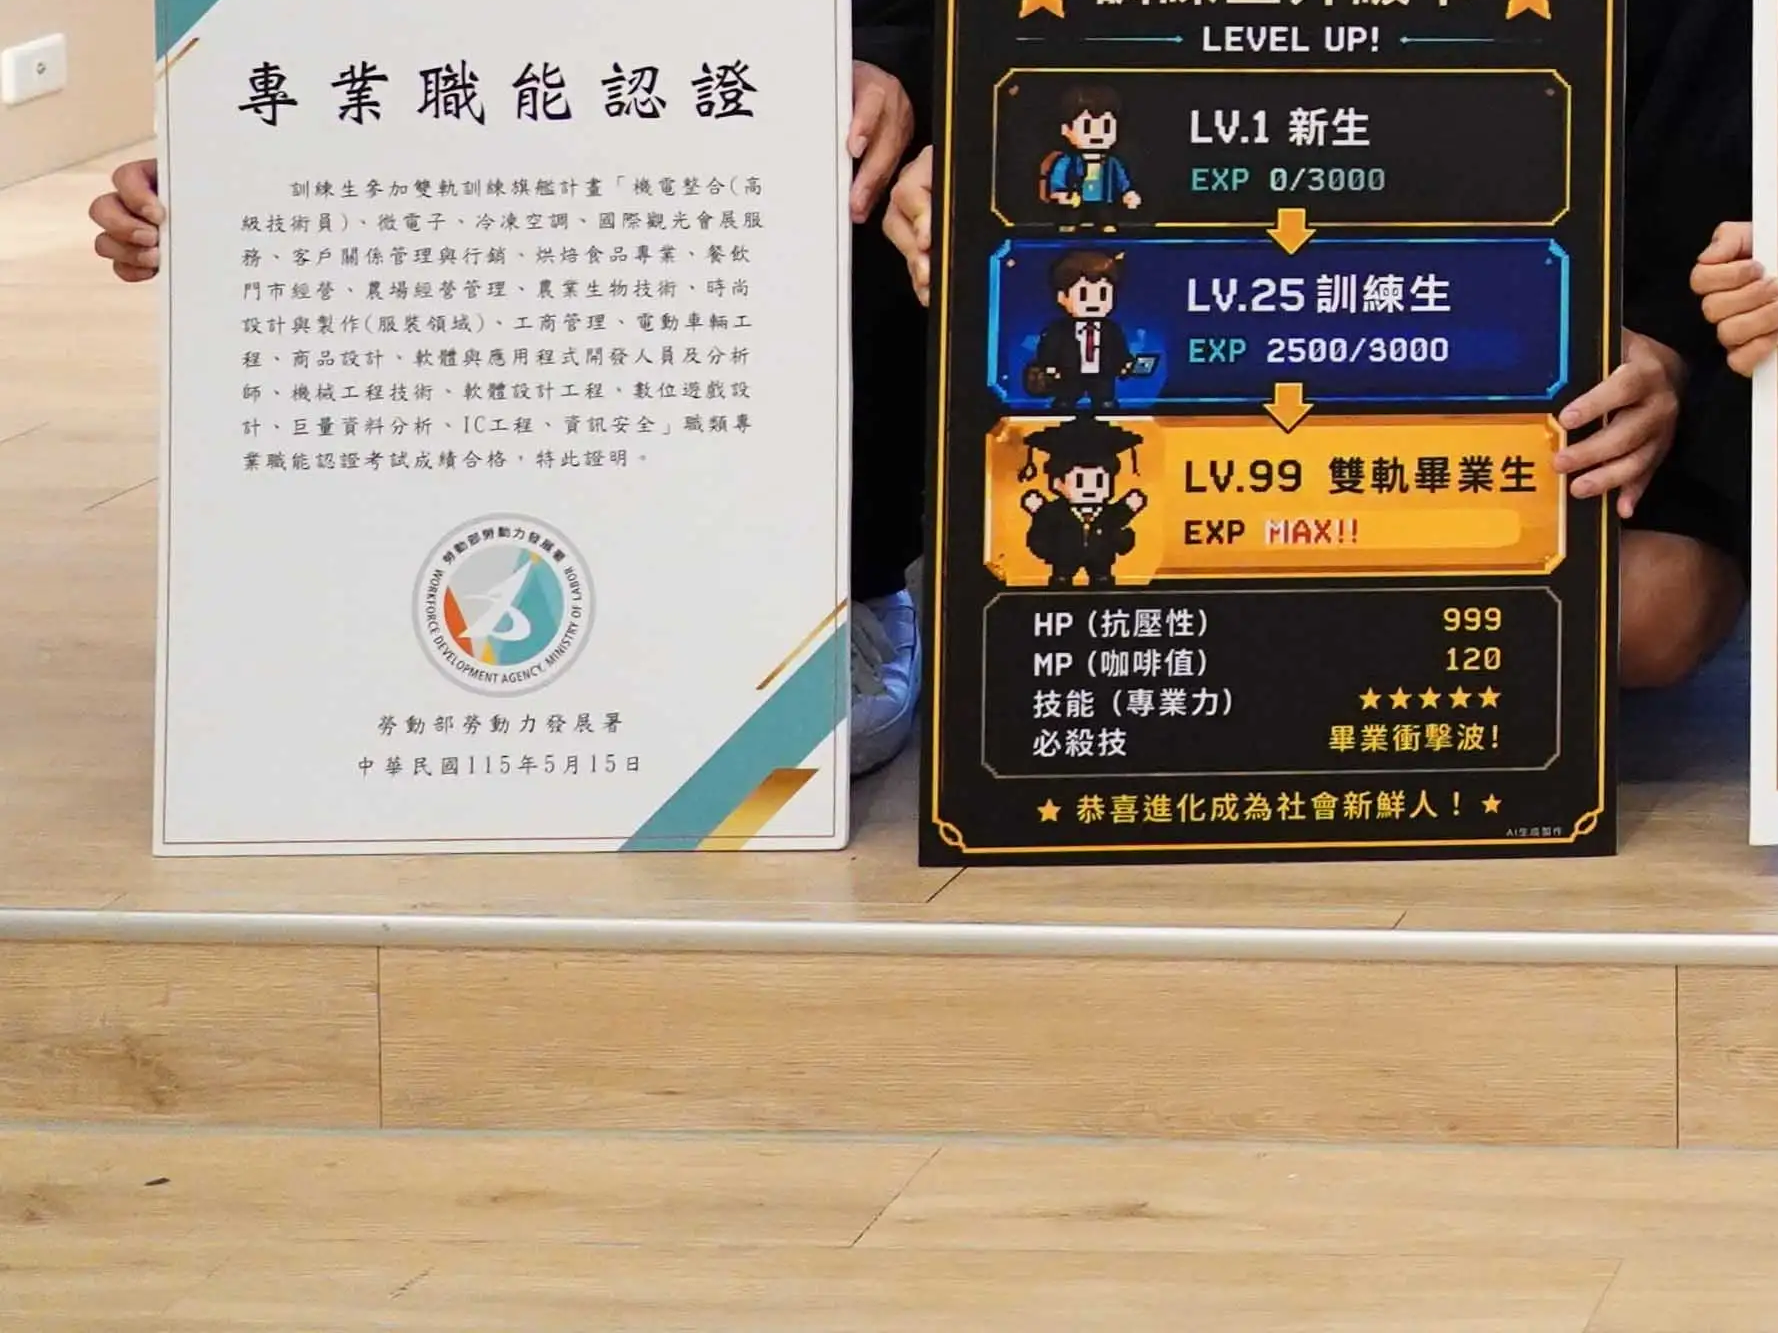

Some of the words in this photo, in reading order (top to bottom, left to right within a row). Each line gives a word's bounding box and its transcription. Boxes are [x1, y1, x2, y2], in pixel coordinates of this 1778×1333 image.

[1202, 25, 1310, 52] LEVEL
[1324, 26, 1379, 53] UP!
[237, 59, 758, 127] 專業職能認證
[1190, 109, 1270, 144] LV.1
[1288, 106, 1371, 147] 新生
[1191, 167, 1250, 191] EXP
[1269, 167, 1385, 192] 0/3000
[1187, 277, 1305, 313] LV.25
[1316, 273, 1451, 314] 訓練生
[1188, 338, 1247, 363] EXP
[1266, 337, 1449, 363] 2500/3000
[1184, 459, 1302, 494] LV.99
[1327, 454, 1537, 495] 雙軌畢業生
[1184, 519, 1246, 546] EXP
[1267, 519, 1359, 545] MAX!!
[564, 566, 582, 600] LABOR
[424, 569, 444, 634] WORKFORCE
[572, 606, 582, 618] OF
[1034, 612, 1074, 637] HP
[1088, 608, 1207, 638] (抗壓性)
[1443, 607, 1502, 632] 999
[433, 635, 498, 683] DEVELOPMENT
[545, 622, 579, 666] MINISTRY
[1446, 646, 1502, 671] 120
[1033, 652, 1073, 677] MP
[1087, 648, 1207, 678] (咖啡值)
[1033, 688, 1095, 719] 技能
[1112, 687, 1232, 718] (專業力)
[377, 711, 623, 737] 勞動部勞動力發展署
[1328, 722, 1499, 753] 畢業衝擊波!
[1032, 727, 1127, 758] 必殺技
[358, 753, 639, 777] 中華民國115年5月15日
[1076, 789, 1460, 824] 恭喜進化成為社會新鮮人！
